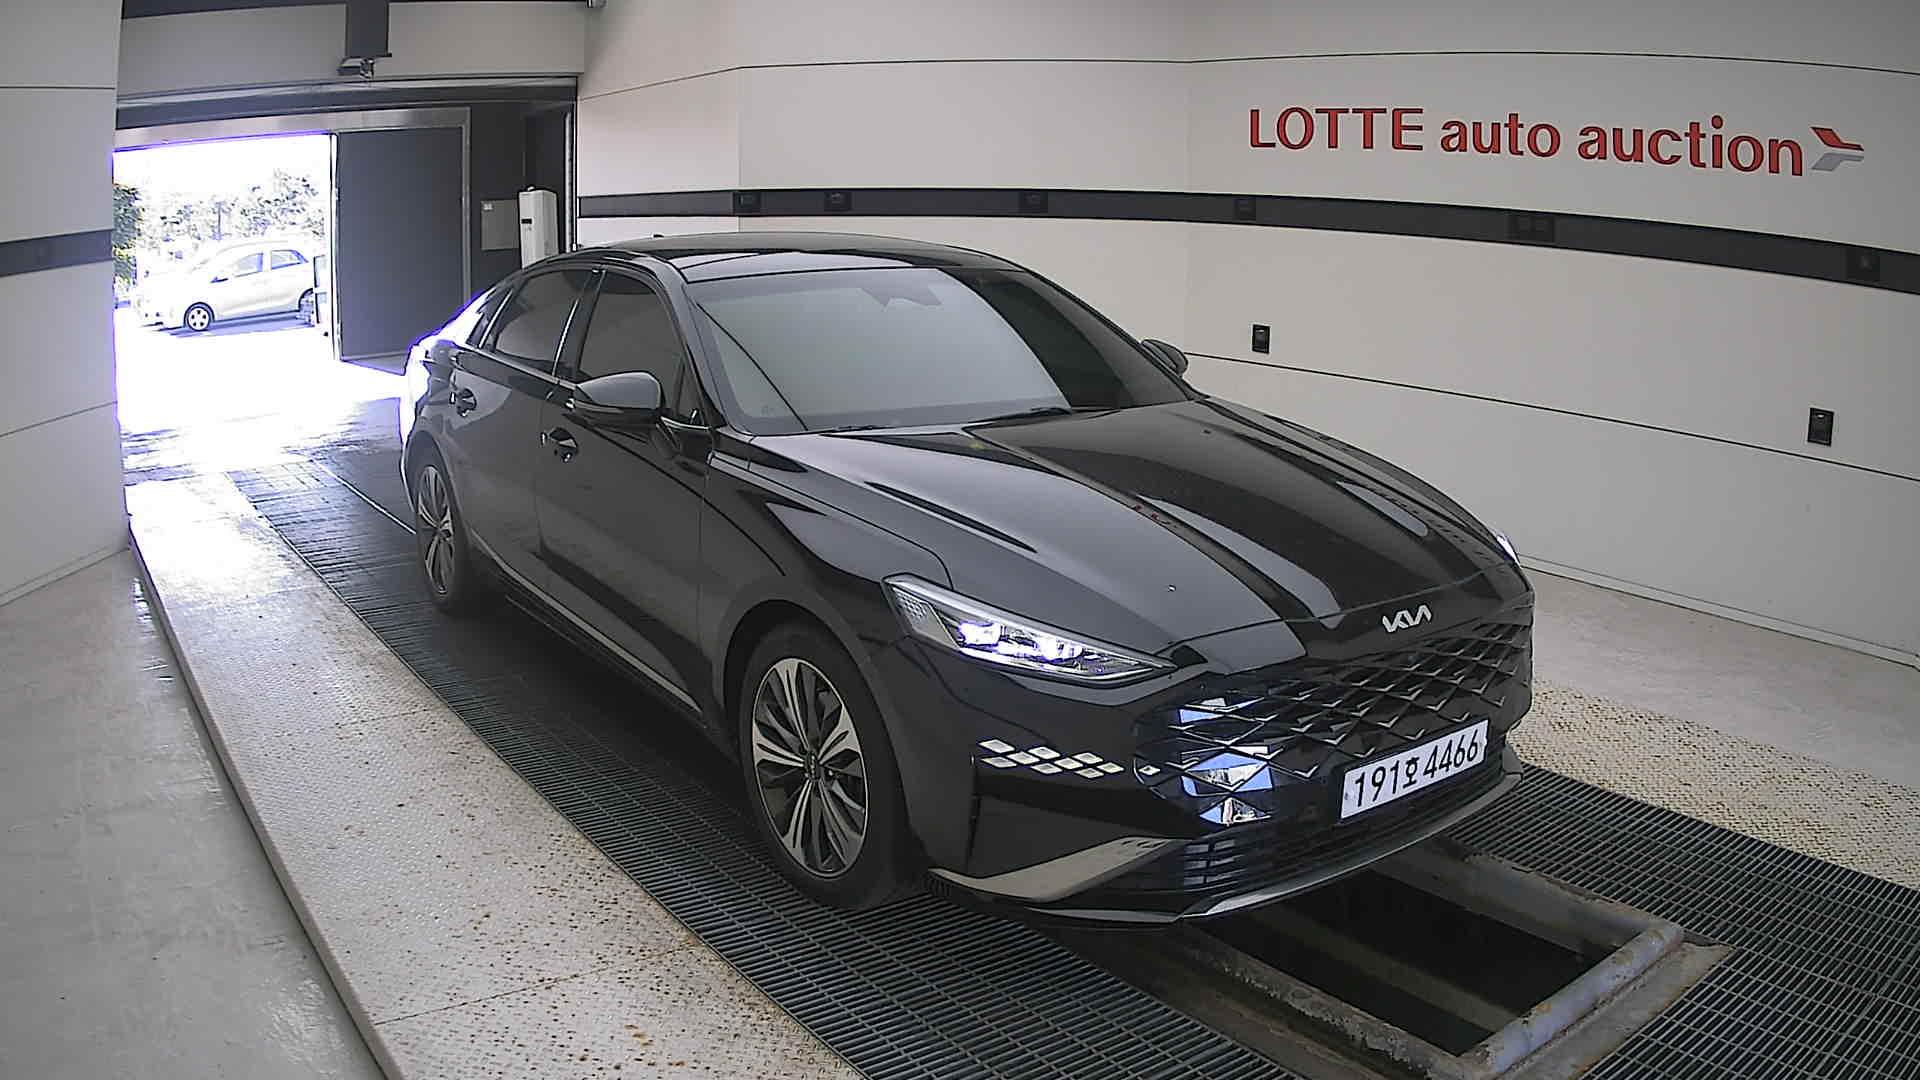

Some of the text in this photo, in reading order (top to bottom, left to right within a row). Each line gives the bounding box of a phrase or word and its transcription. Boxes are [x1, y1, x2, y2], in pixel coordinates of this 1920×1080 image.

[1249, 107, 1804, 176] LOTTE auto auction
